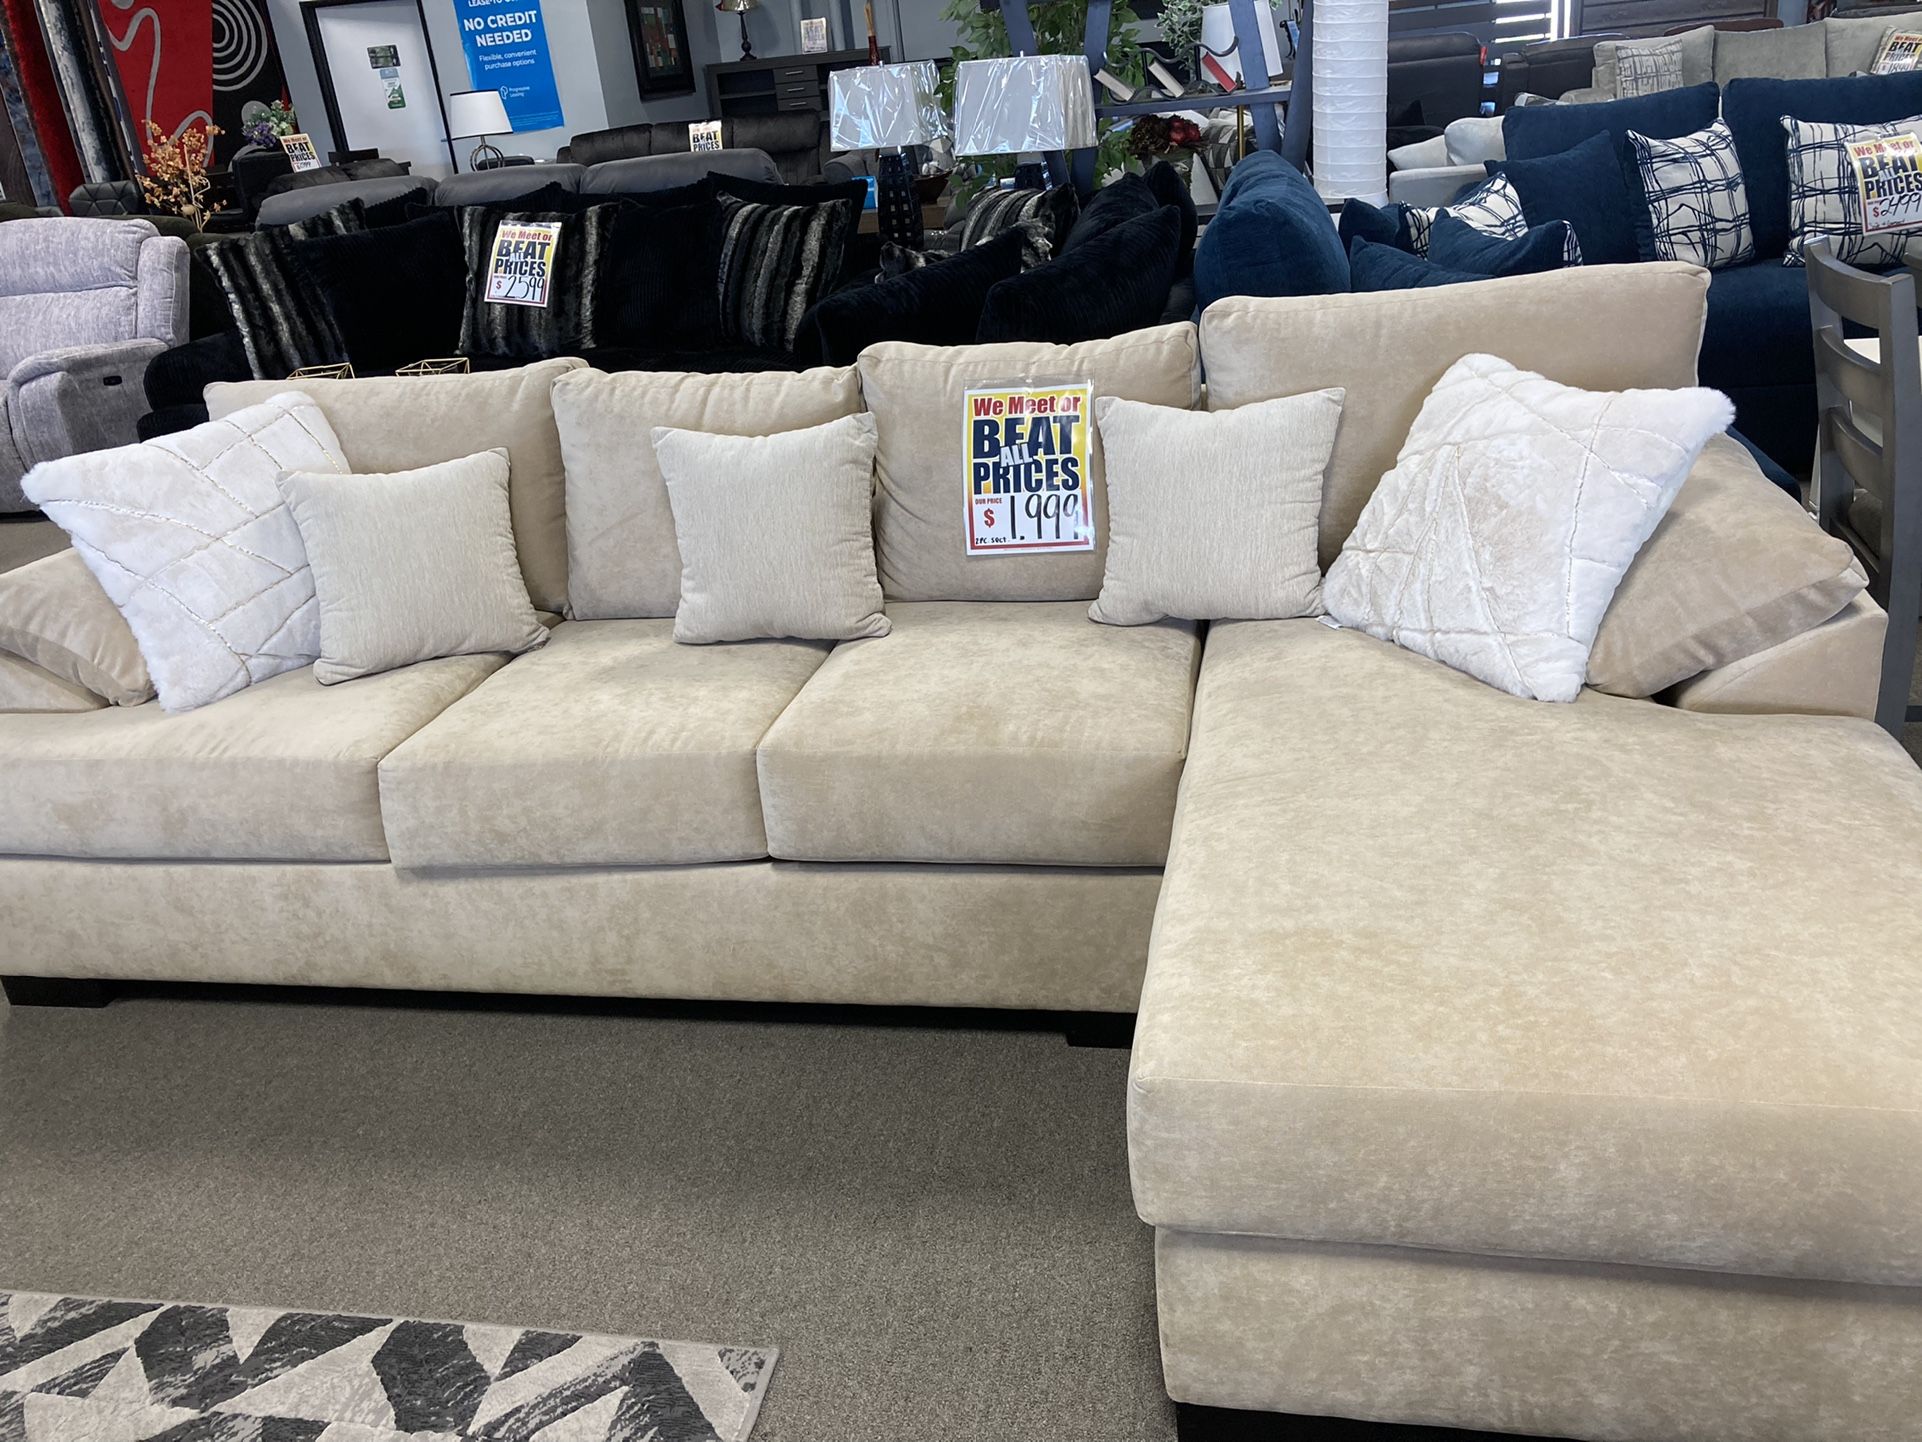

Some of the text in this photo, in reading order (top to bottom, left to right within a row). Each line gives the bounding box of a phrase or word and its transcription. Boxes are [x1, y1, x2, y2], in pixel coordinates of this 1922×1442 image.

[463, 10, 537, 31] NO CREDIT
[475, 29, 532, 47] NEEDED
[1888, 41, 1922, 53] BEAT
[479, 49, 537, 61] Flexible, convenient
[484, 59, 535, 70] purchase options
[692, 130, 719, 143] BEAT
[286, 142, 310, 154] BEAT
[693, 141, 720, 151] PRICES
[1854, 140, 1914, 156] We Met or
[290, 152, 315, 162] PRICES
[1859, 153, 1918, 179] BEAT
[1878, 168, 1897, 182] ALL
[1864, 172, 1922, 200] PRICES
[1873, 192, 1921, 217] $ 2499
[502, 230, 552, 241] We Meet or
[497, 239, 551, 260] BEAT
[510, 252, 525, 262] ALL
[494, 259, 546, 277] PRICES
[496, 275, 545, 301] $ 2599
[973, 396, 1081, 416] We Meet or
[973, 415, 1080, 460] BEAT
[1001, 443, 1033, 467] ALL
[973, 457, 1080, 495] PRICES
[984, 508, 995, 528] $
